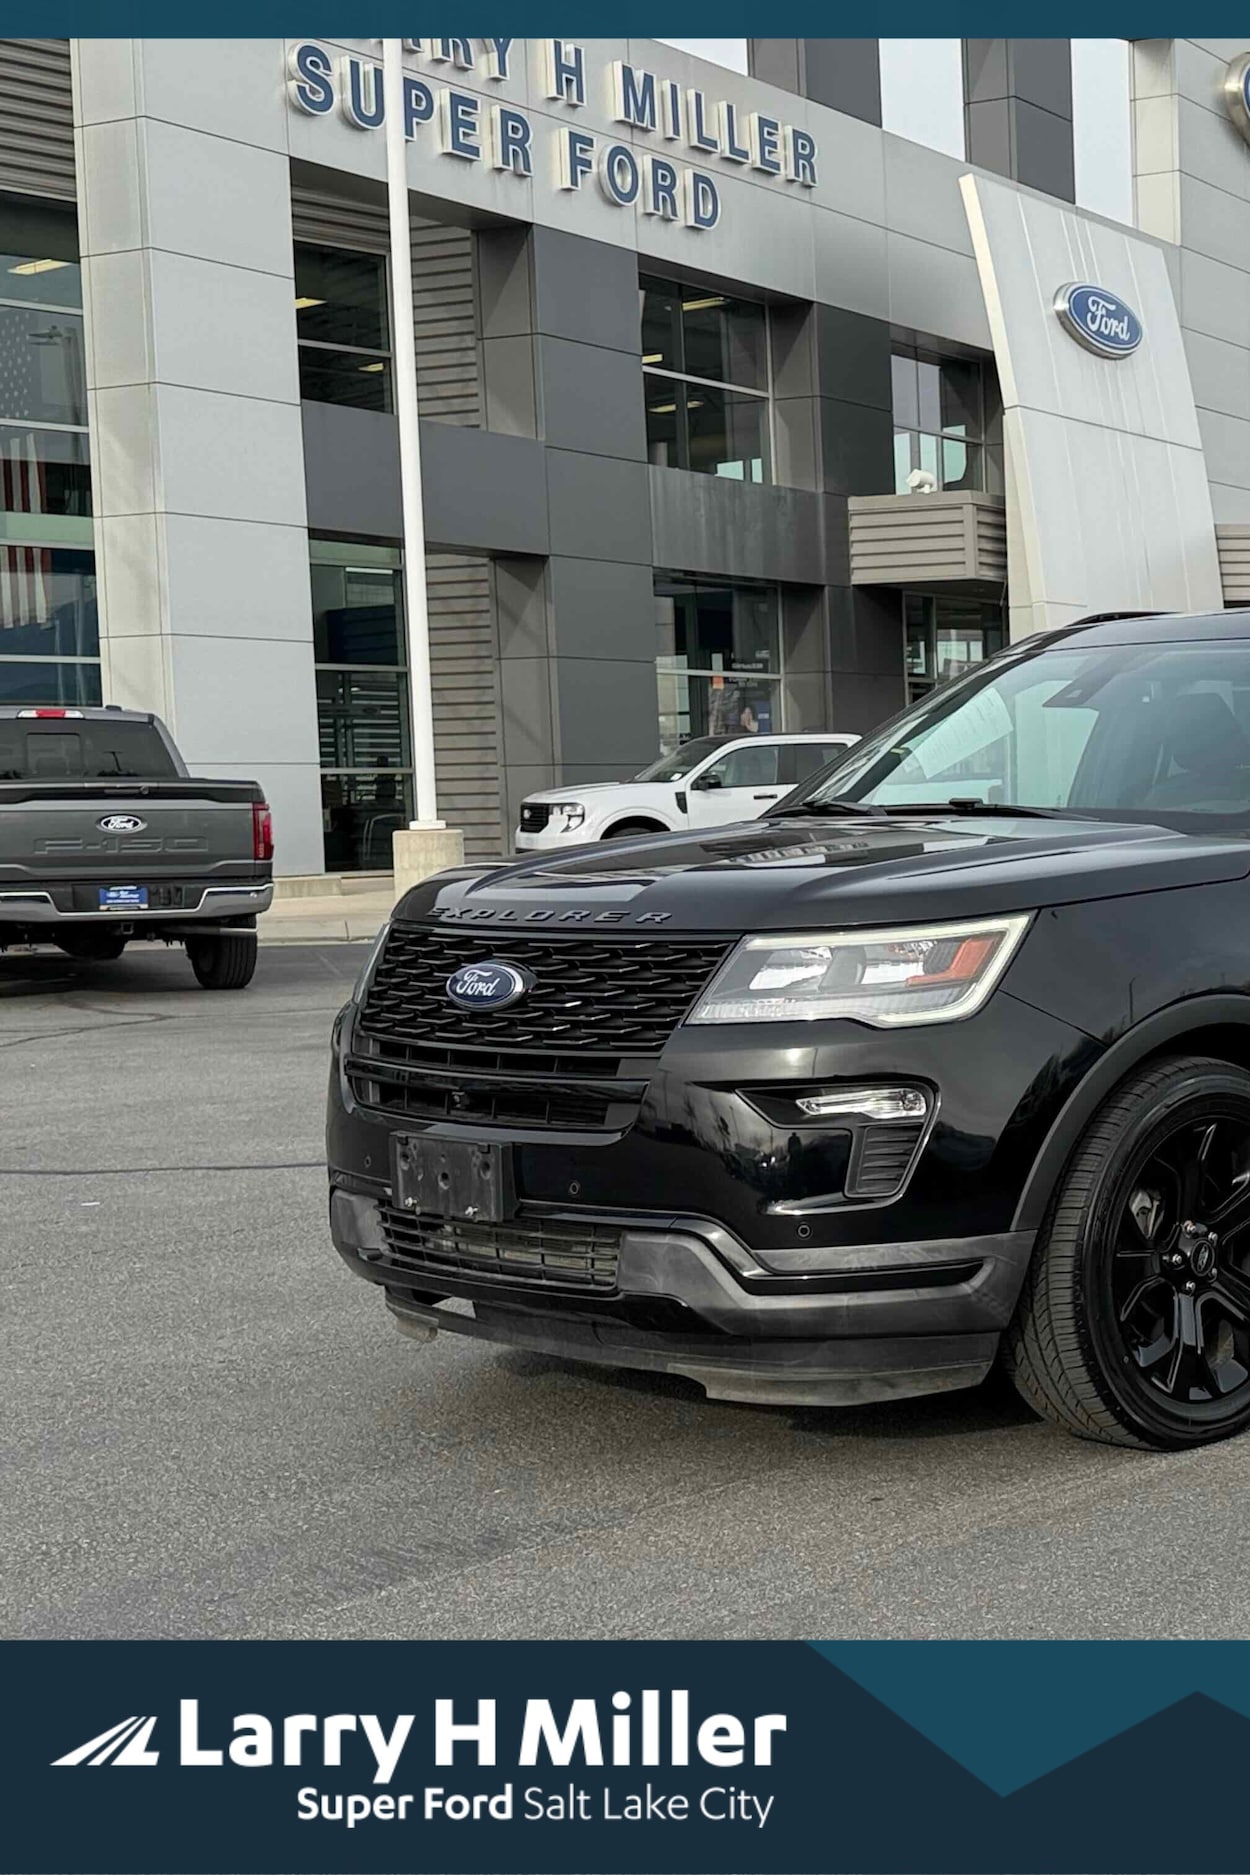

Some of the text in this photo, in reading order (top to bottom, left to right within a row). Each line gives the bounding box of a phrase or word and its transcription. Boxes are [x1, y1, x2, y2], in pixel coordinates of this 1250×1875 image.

[289, 40, 533, 177] SUPER
[545, 38, 586, 107] H
[613, 60, 818, 187] MILLER
[560, 127, 721, 231] FORD
[1087, 295, 1130, 341] Ford
[33, 837, 209, 855] F-150
[426, 907, 672, 924] EXPLORER
[456, 968, 501, 997] Ford
